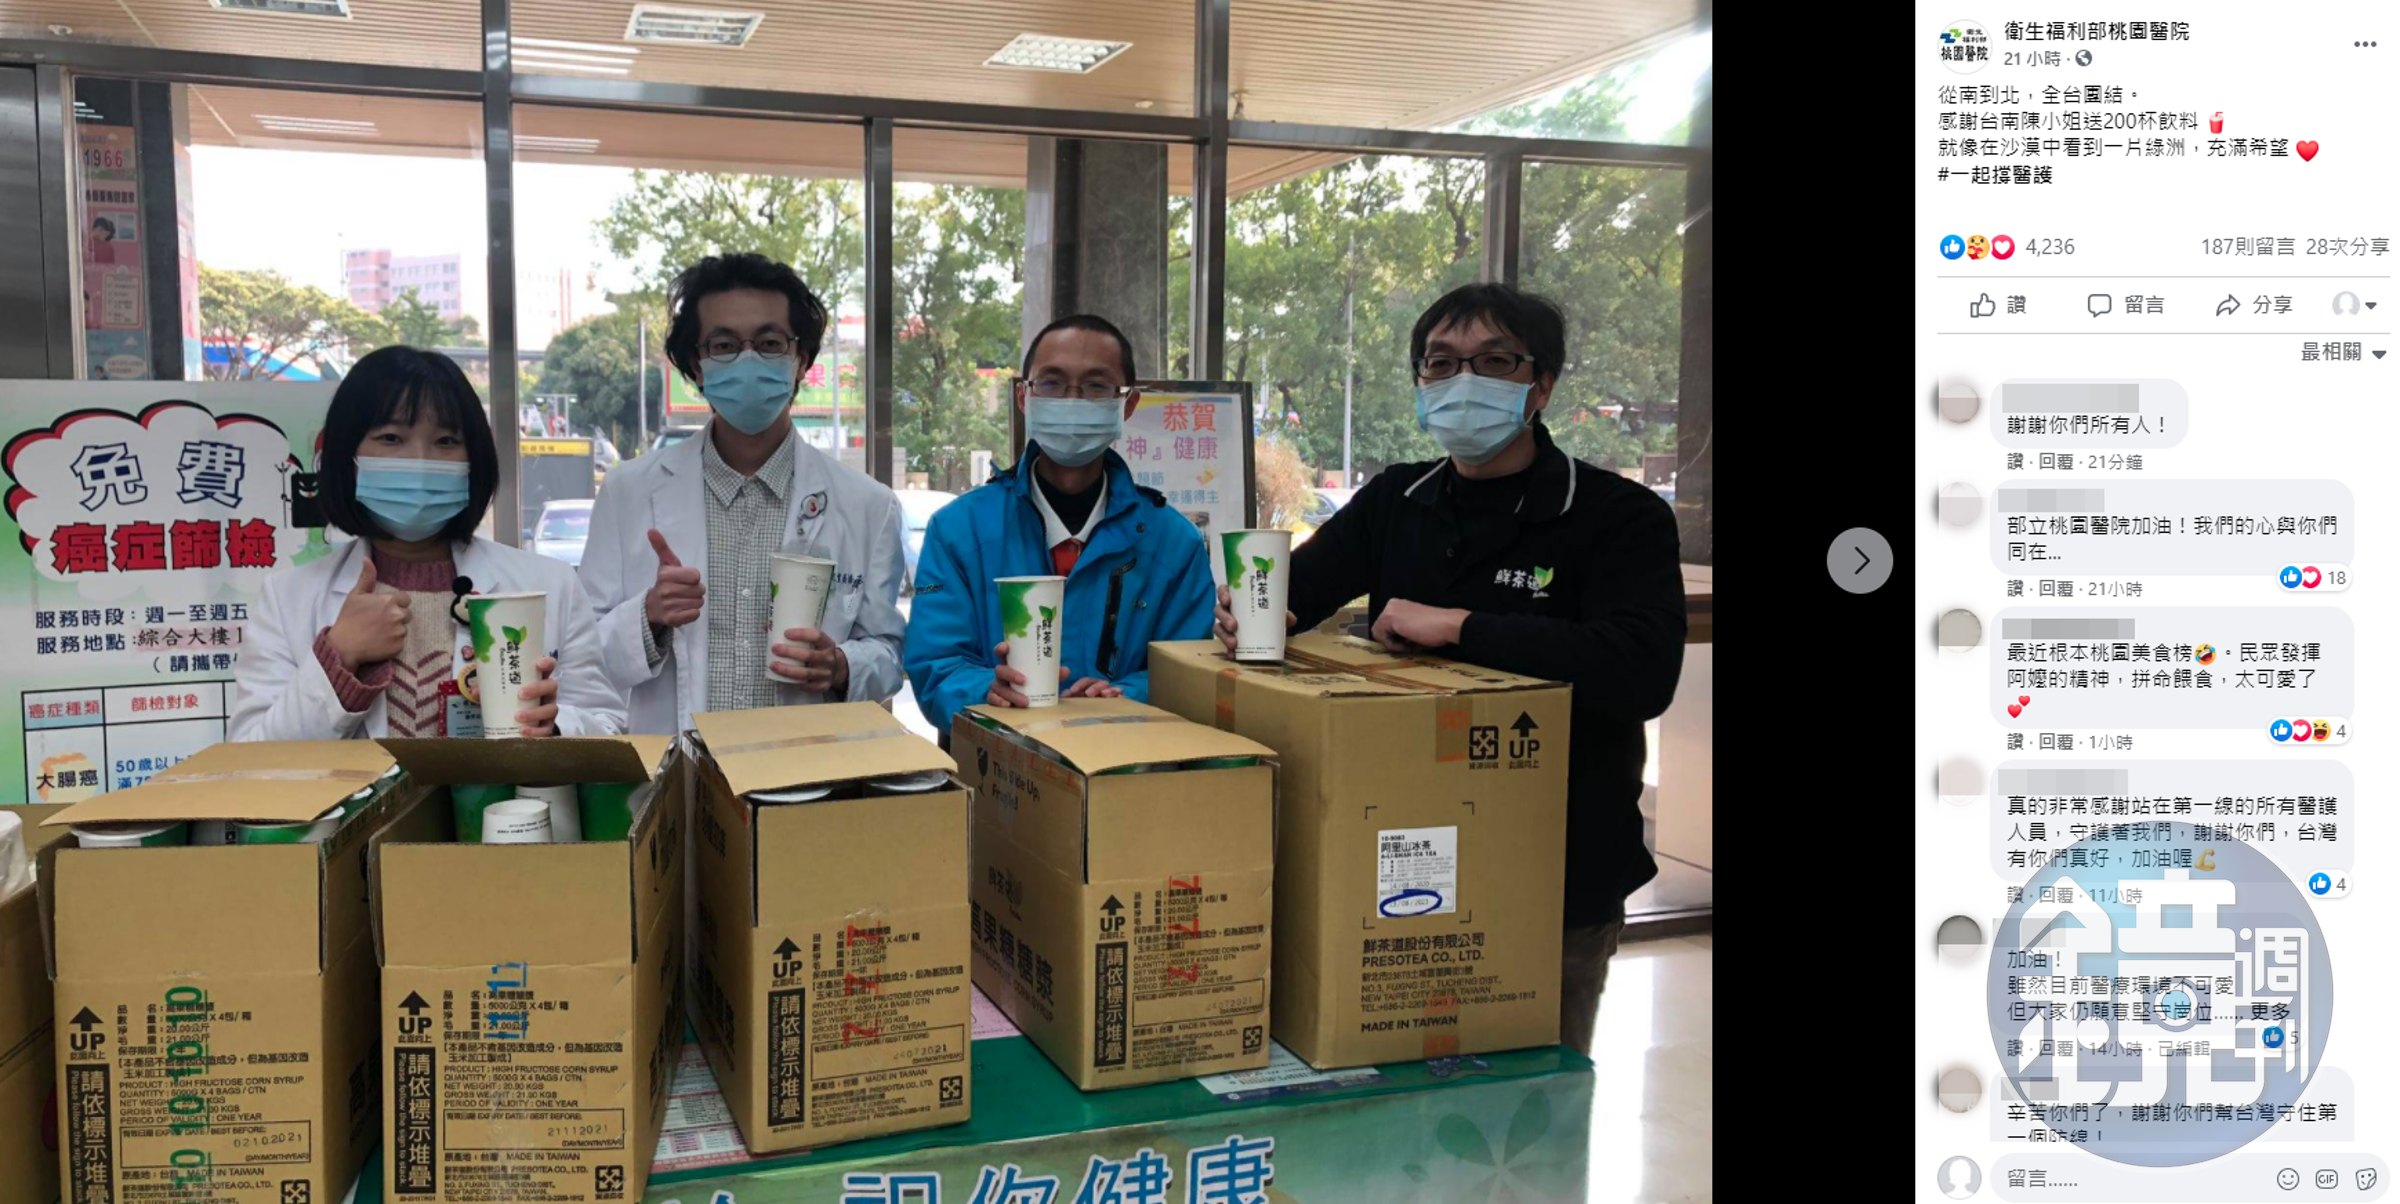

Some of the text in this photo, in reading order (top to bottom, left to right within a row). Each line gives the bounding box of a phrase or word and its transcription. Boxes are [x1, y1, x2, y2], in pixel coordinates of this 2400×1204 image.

[2005, 21, 2189, 40] 衛生福利部桃園醫院
[1941, 45, 1988, 62] 桃園醫院
[2004, 51, 2061, 67] 21 小時
[1939, 85, 2137, 104] 從南到北，全台團結。
[1938, 110, 2198, 130] 感謝台南陳小姐送200杯飲料
[1938, 137, 2289, 156] 就像在沙漠中看到一片綠洲，充滿希望
[84, 149, 122, 167] 1966
[1937, 165, 2052, 184] #一起撐醫護
[2026, 239, 2074, 257] 4,236
[2202, 237, 2389, 256] 187則留言 28次分享
[2007, 295, 2292, 314] 讚 留言 分享
[2302, 342, 2361, 360] 最相關
[1163, 403, 1216, 432] 恭賀
[2008, 415, 2163, 434] 謝謝你們所有人！
[2008, 453, 2142, 470] 讚 回覆 21分鐘
[70, 440, 245, 512] 免費
[2008, 516, 2337, 535] 部立桃園醫院加油！我們的心與你們
[50, 518, 277, 575] 癌症篩檢
[2009, 542, 2061, 561] 同在...
[2328, 571, 2346, 584] 18
[1256, 570, 1269, 610] 鮮茶道
[2008, 580, 2142, 597] 讚 回覆 21小時
[36, 604, 248, 629] 服務時段：週一至週五
[2007, 644, 2192, 663] 最近根本桃園美食榜
[152, 653, 238, 673] （請攜帶
[2008, 668, 2315, 688] 阿嬤的精神，拼命餵食，太可愛了
[29, 700, 100, 718] 癌症種類
[131, 694, 199, 711] 篩檢對象
[2336, 725, 2346, 737] 4
[1510, 740, 1540, 758] UP
[2007, 733, 2133, 750] 讚 回覆 1小時
[116, 755, 192, 772] 50歲以
[36, 770, 98, 790] 大腸癌
[2007, 797, 2337, 815] 真的非常感謝站在第一線的所有醫護
[2007, 823, 2337, 842] 人員，守護著我們，謝謝你們，台灣
[1381, 840, 1431, 852] 阿里山冰茶
[2007, 849, 2192, 868] 有你們真好，加油喔
[2336, 878, 2346, 891] 4
[2039, 887, 2073, 904] 回覆
[2089, 888, 2143, 903] 11小時
[1100, 917, 1125, 932] UP
[1363, 932, 1484, 954] 鮮茶道股份有限公司
[1362, 950, 1484, 967] PRESOTEA CO., LTD.
[2007, 950, 2061, 969] 加油！
[773, 960, 802, 979] UP
[1460, 987, 1491, 995] TAIWAN
[2007, 976, 2233, 995] 雖然目前醫療環境不可愛
[1105, 948, 1124, 1061] 請依標示堆疊
[2250, 1001, 2291, 1020] 更多
[399, 1017, 432, 1034] UP
[1361, 1015, 1458, 1032] MADE IN TAIWAN
[70, 1033, 106, 1050] UP
[2291, 1032, 2298, 1044] 5
[781, 995, 801, 1119] 請依標示堆疊
[2039, 1040, 2073, 1057] 回覆
[2089, 1041, 2142, 1056] 14小時
[2158, 1040, 2211, 1057] 已編輯
[120, 1081, 163, 1089] PRODUCT
[194, 1078, 243, 1086] FRUCTOSE
[273, 1076, 304, 1084] SYRUP
[865, 1073, 887, 1083] MADE
[120, 1086, 266, 1098] QUANTITY BAGS CTN
[120, 1116, 155, 1124] PERIOD
[217, 1113, 237, 1121] ONE
[408, 1053, 431, 1187] 請依標示堆疊
[2007, 1103, 2337, 1121] 辛苦你們了，謝謝你們幫台灣守住第
[81, 1071, 109, 1204] 請依標示堆疊
[233, 1133, 302, 1148] 02102021
[228, 1168, 265, 1176] TAIWAN
[2318, 1174, 2335, 1184] GIF
